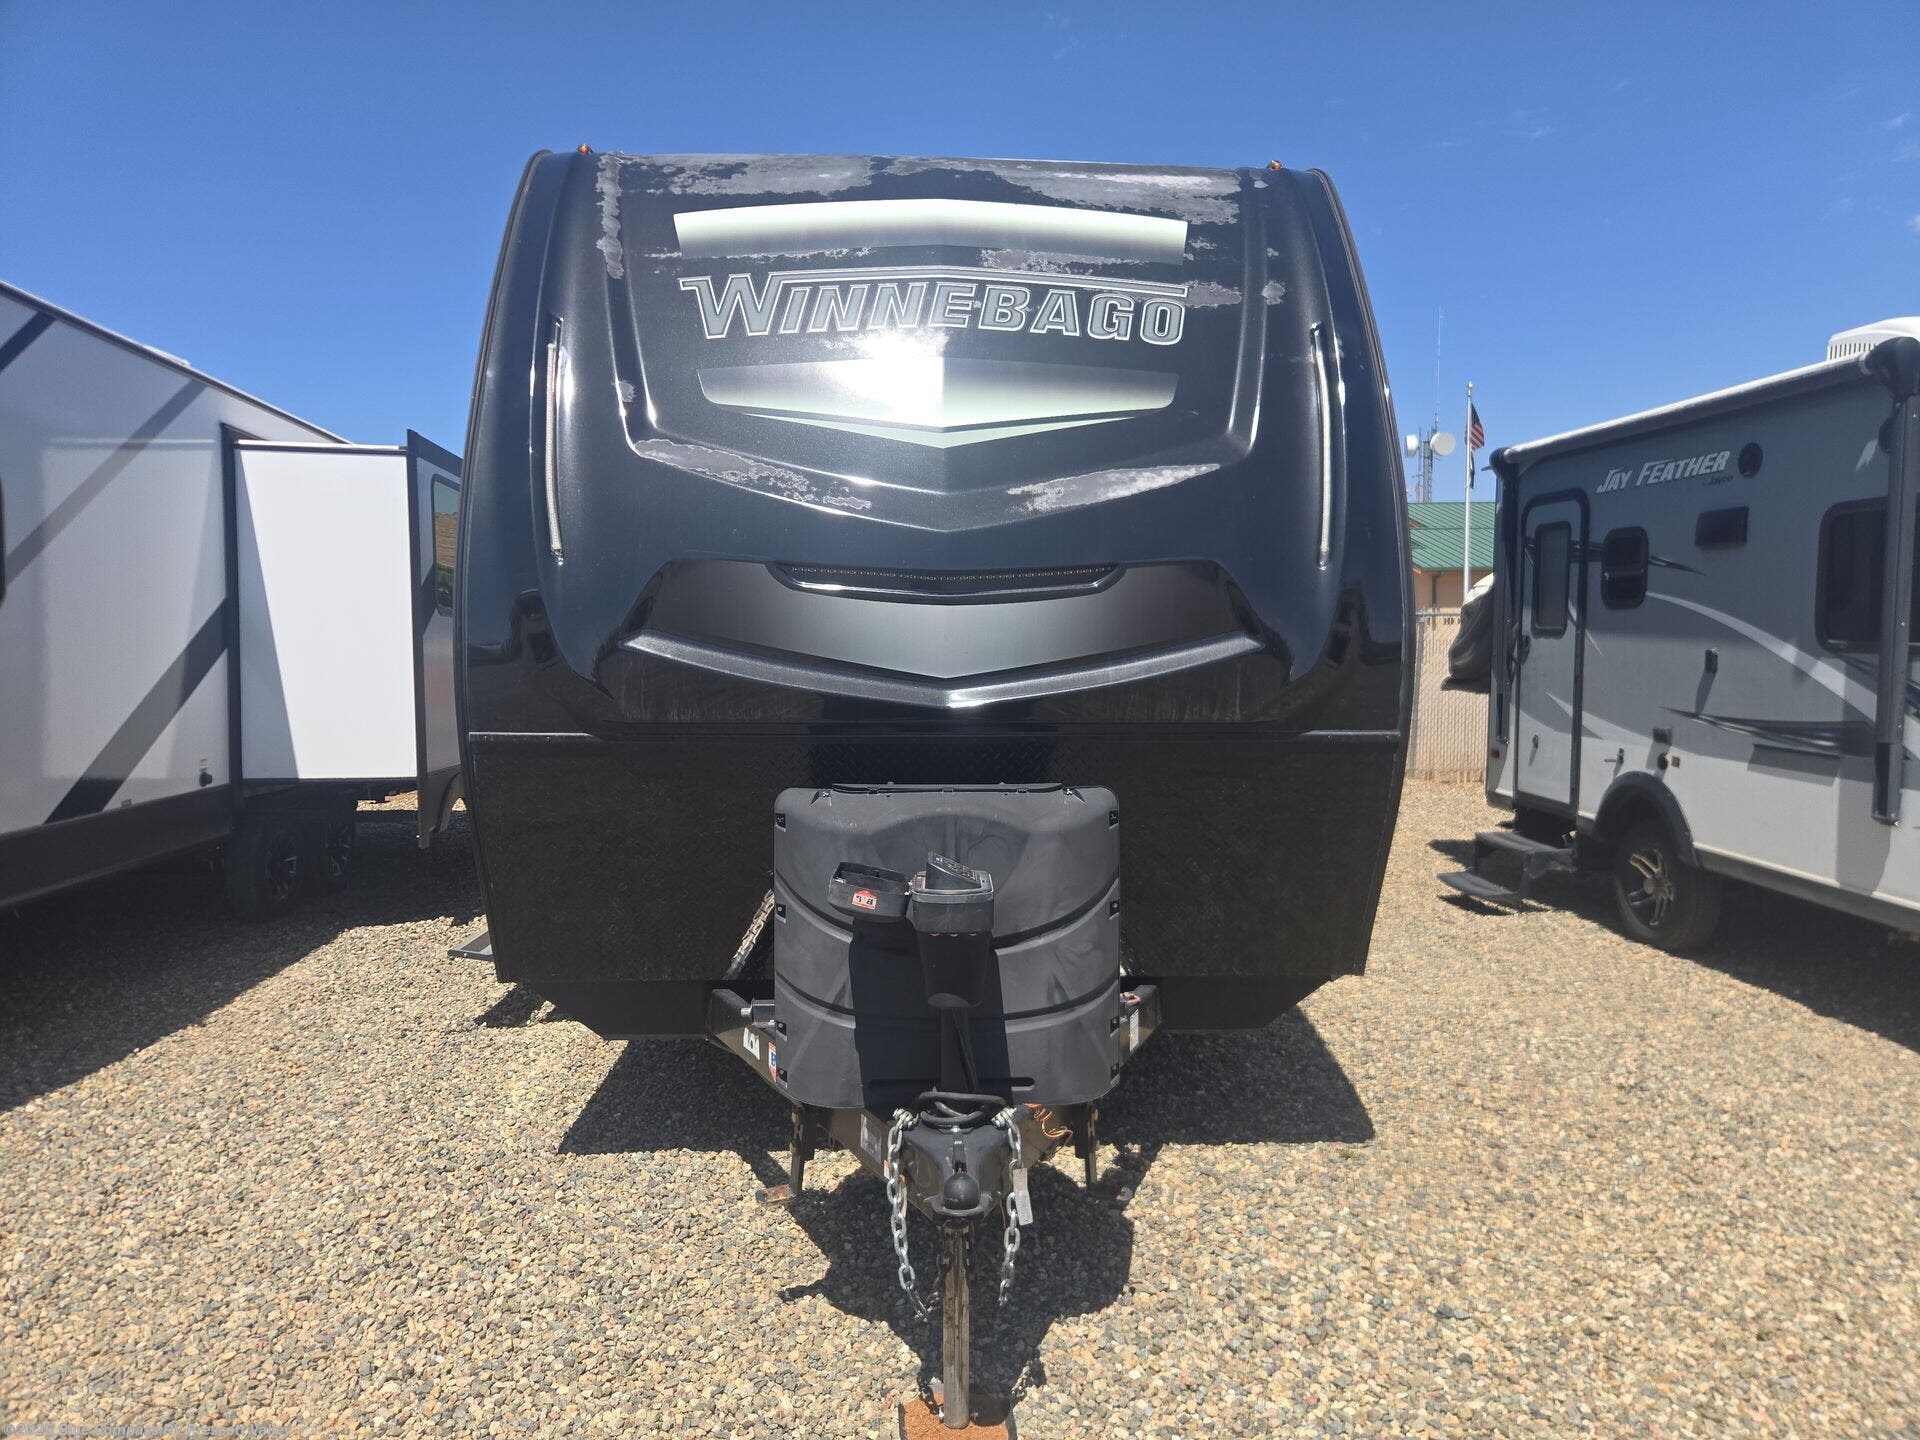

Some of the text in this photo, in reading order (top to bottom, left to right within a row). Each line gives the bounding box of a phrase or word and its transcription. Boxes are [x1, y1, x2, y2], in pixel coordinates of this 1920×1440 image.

[678, 265, 1189, 345] WINNEBAGO
[1596, 467, 1632, 494] JAY
[1635, 451, 1730, 486] FEATHER
